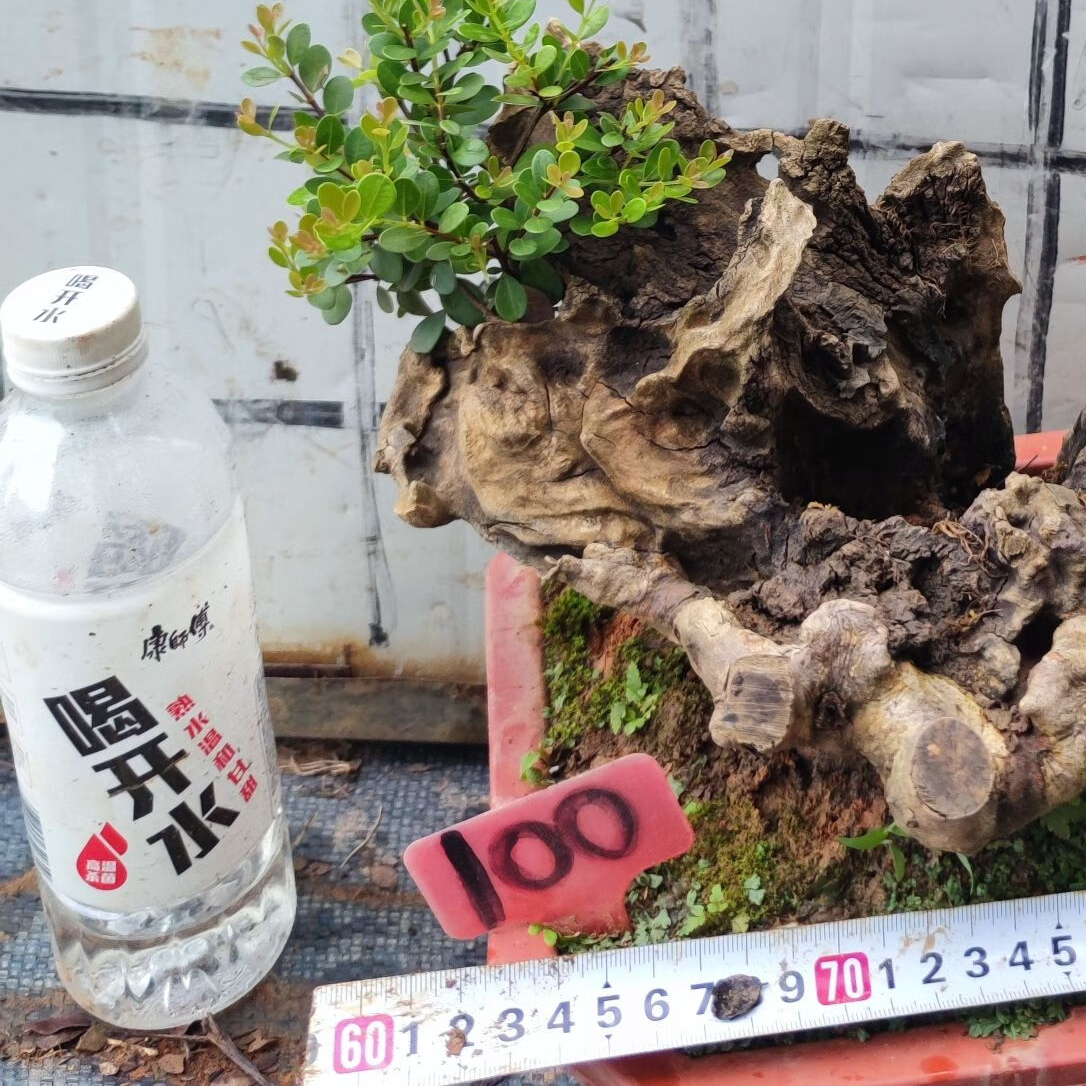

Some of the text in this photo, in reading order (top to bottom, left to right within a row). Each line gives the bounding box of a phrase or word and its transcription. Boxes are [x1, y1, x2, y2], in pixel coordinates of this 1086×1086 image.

[33, 273, 99, 323] 喝开水
[43, 675, 240, 876] 喝开水
[440, 787, 640, 931] 100
[340, 1020, 387, 1070] 60
[400, 1021, 419, 1055] 1
[447, 1013, 475, 1051] 2
[498, 1007, 526, 1042] 3
[547, 1001, 576, 1034] 4
[597, 994, 622, 1028] 5
[643, 988, 670, 1021] 6
[690, 981, 716, 1015] 7
[778, 970, 805, 1004] 9
[820, 958, 866, 1002] 70
[879, 957, 896, 989] 1
[919, 951, 947, 985] 2
[963, 946, 990, 978] 3
[1008, 940, 1035, 971] 4
[1051, 935, 1077, 966] 5
